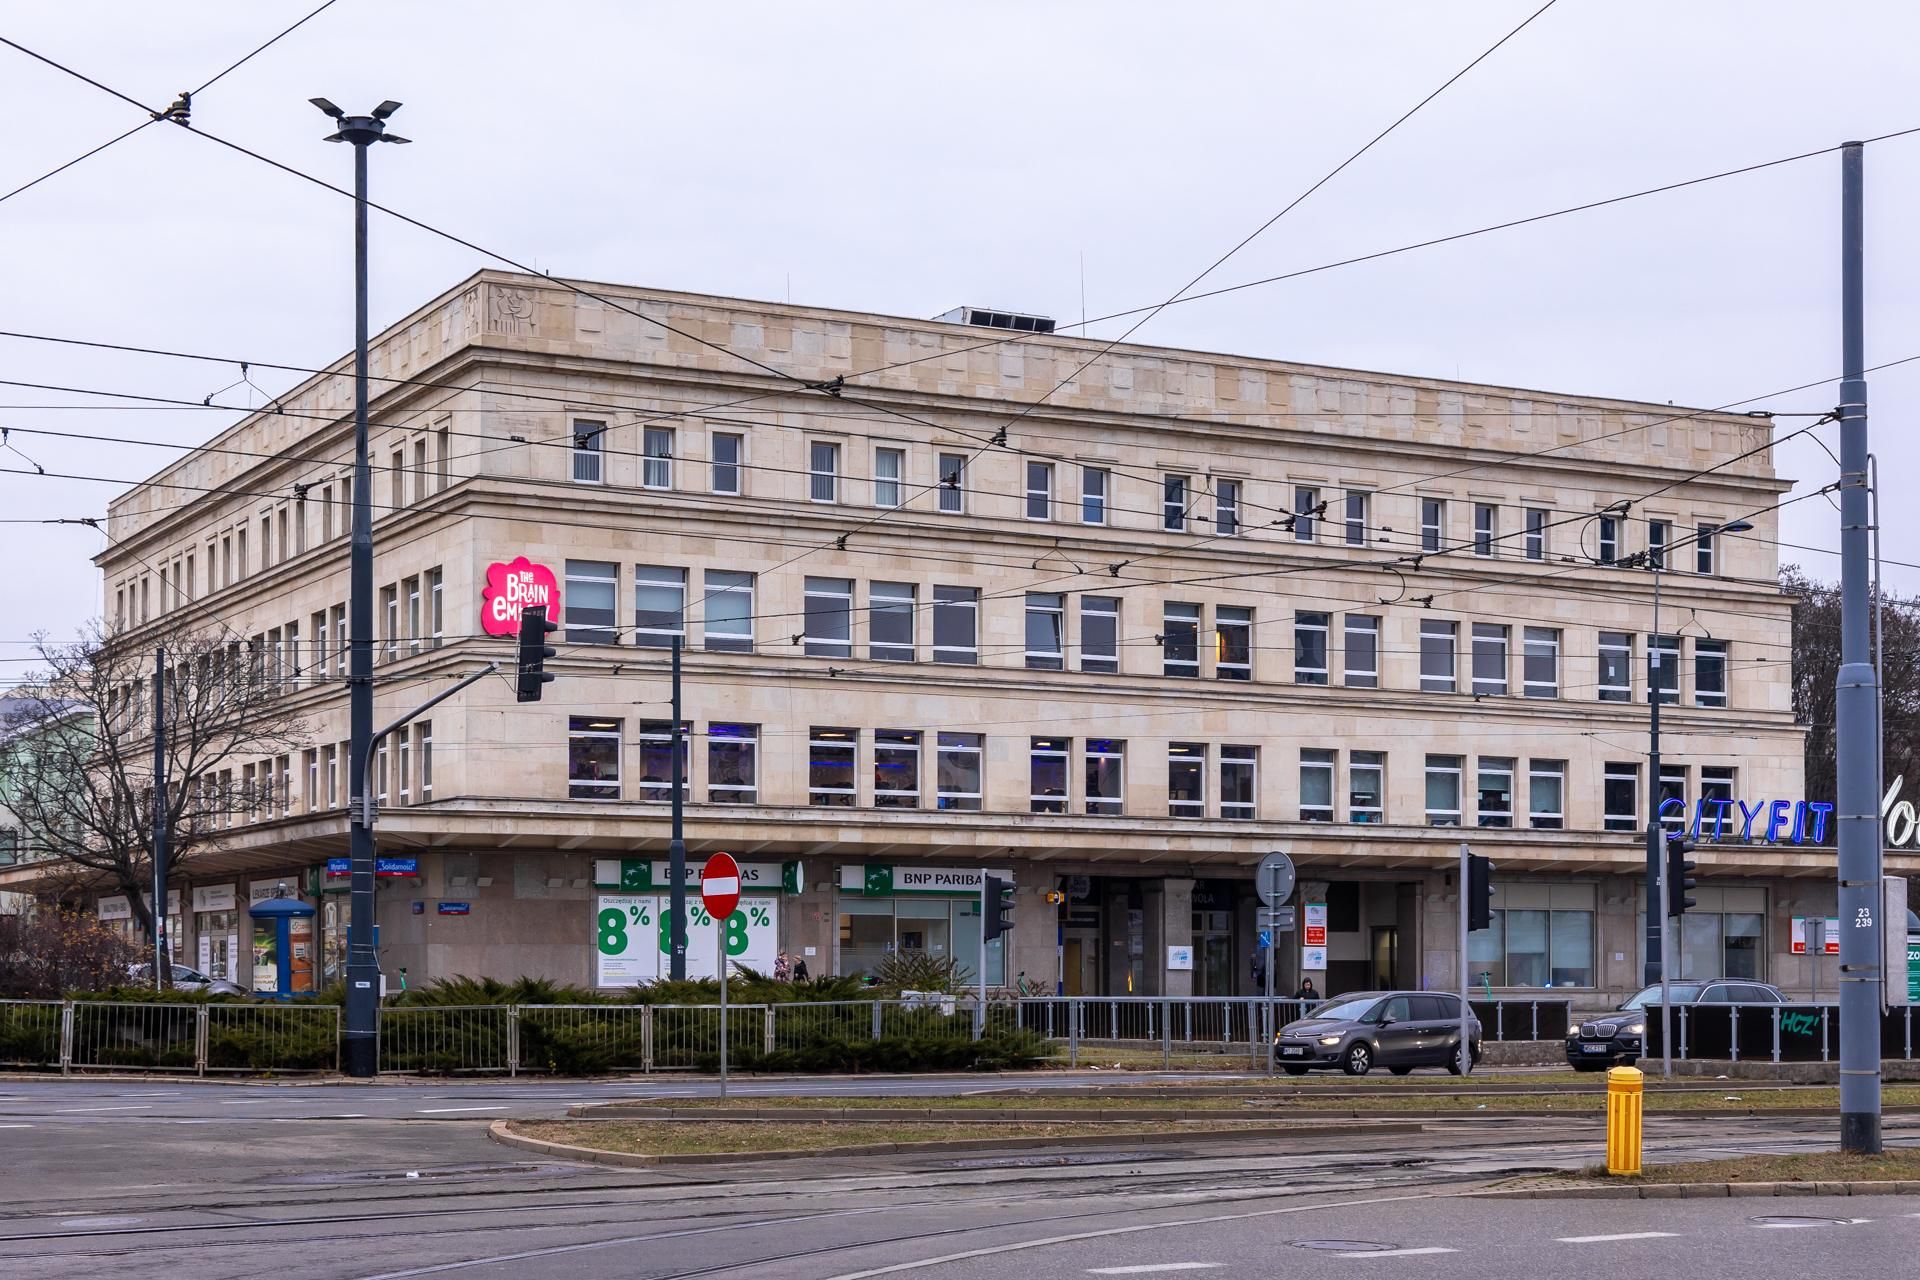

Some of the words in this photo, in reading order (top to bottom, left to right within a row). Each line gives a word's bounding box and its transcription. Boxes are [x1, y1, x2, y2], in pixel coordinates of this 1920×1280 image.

[506, 573, 549, 604] BRAIN
[1658, 797, 1834, 844] CITYFIT
[664, 868, 694, 879] BP
[904, 873, 931, 884] BNP
[935, 874, 983, 886] PARIBA
[1858, 908, 1870, 918] 23
[1855, 918, 1872, 928] 239
[598, 906, 650, 955] 8%
